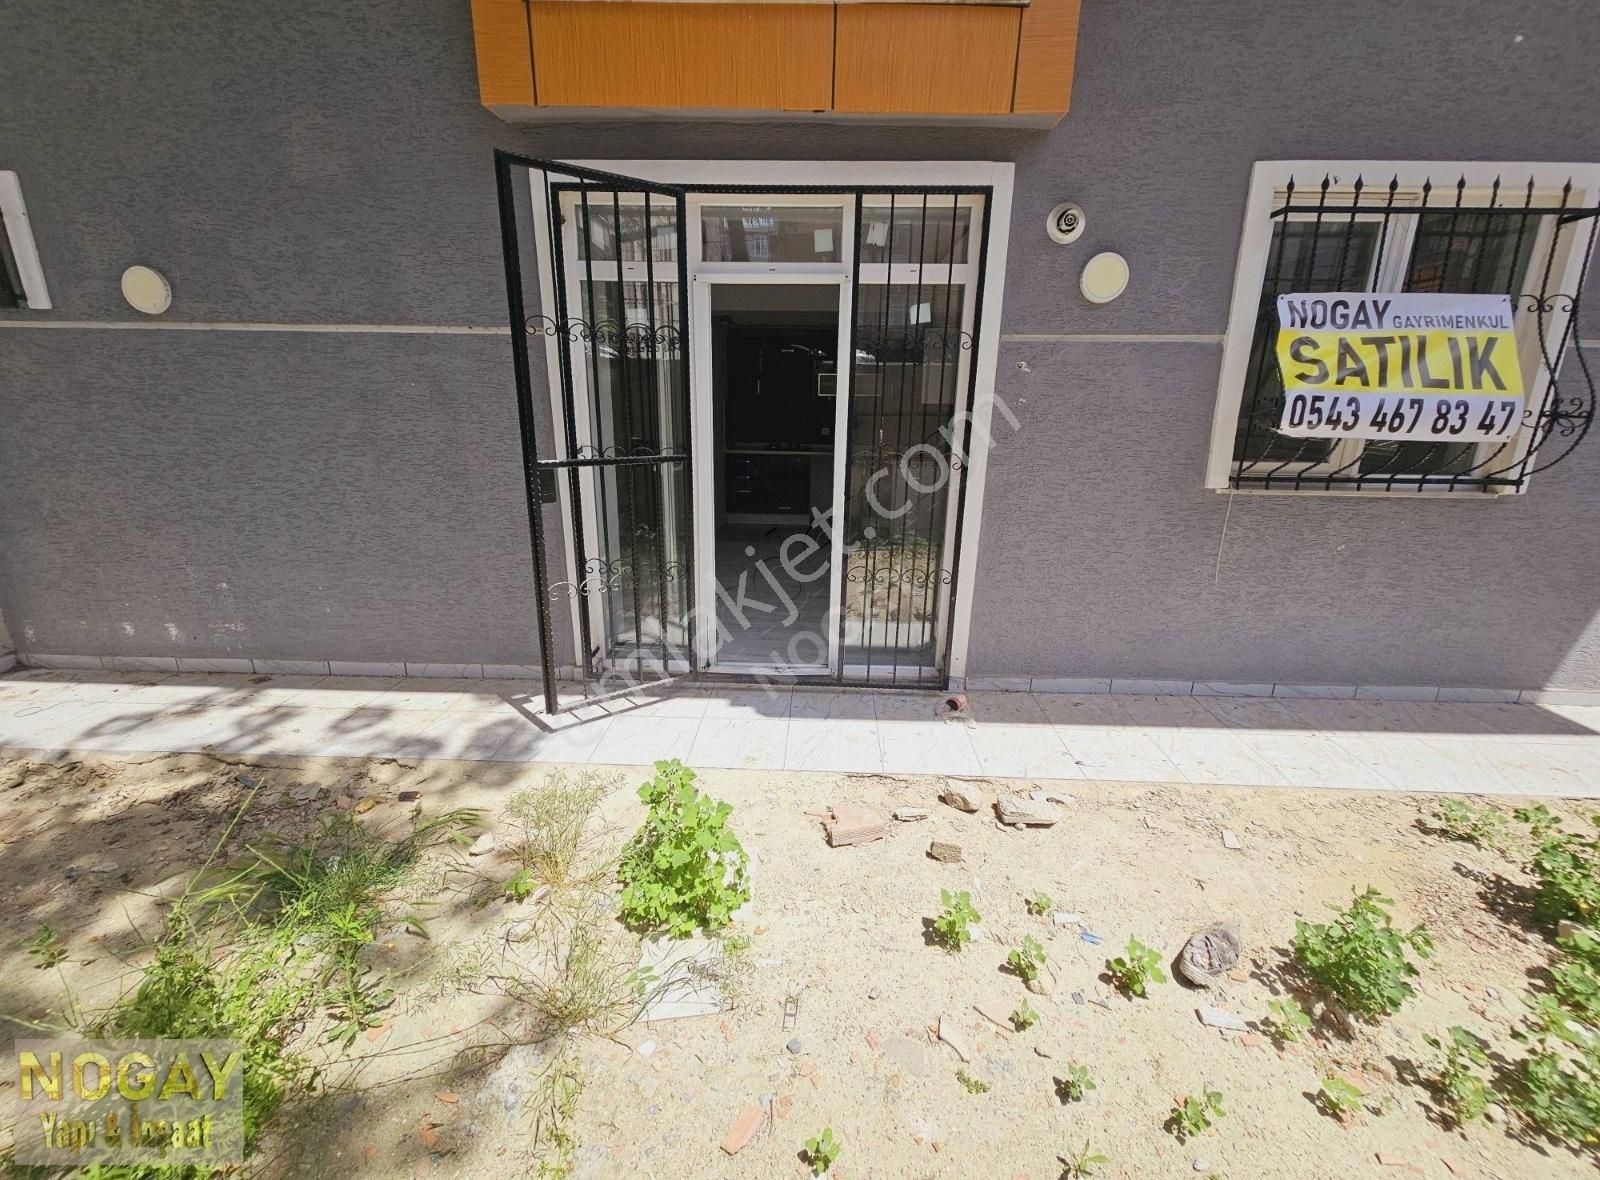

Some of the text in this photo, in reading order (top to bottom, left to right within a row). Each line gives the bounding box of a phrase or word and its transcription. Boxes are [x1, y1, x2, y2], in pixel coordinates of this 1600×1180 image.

[1288, 300, 1392, 330] NOGAY
[1291, 335, 1508, 390] SATILIK
[1288, 394, 1517, 436] 0543 467 83 47
